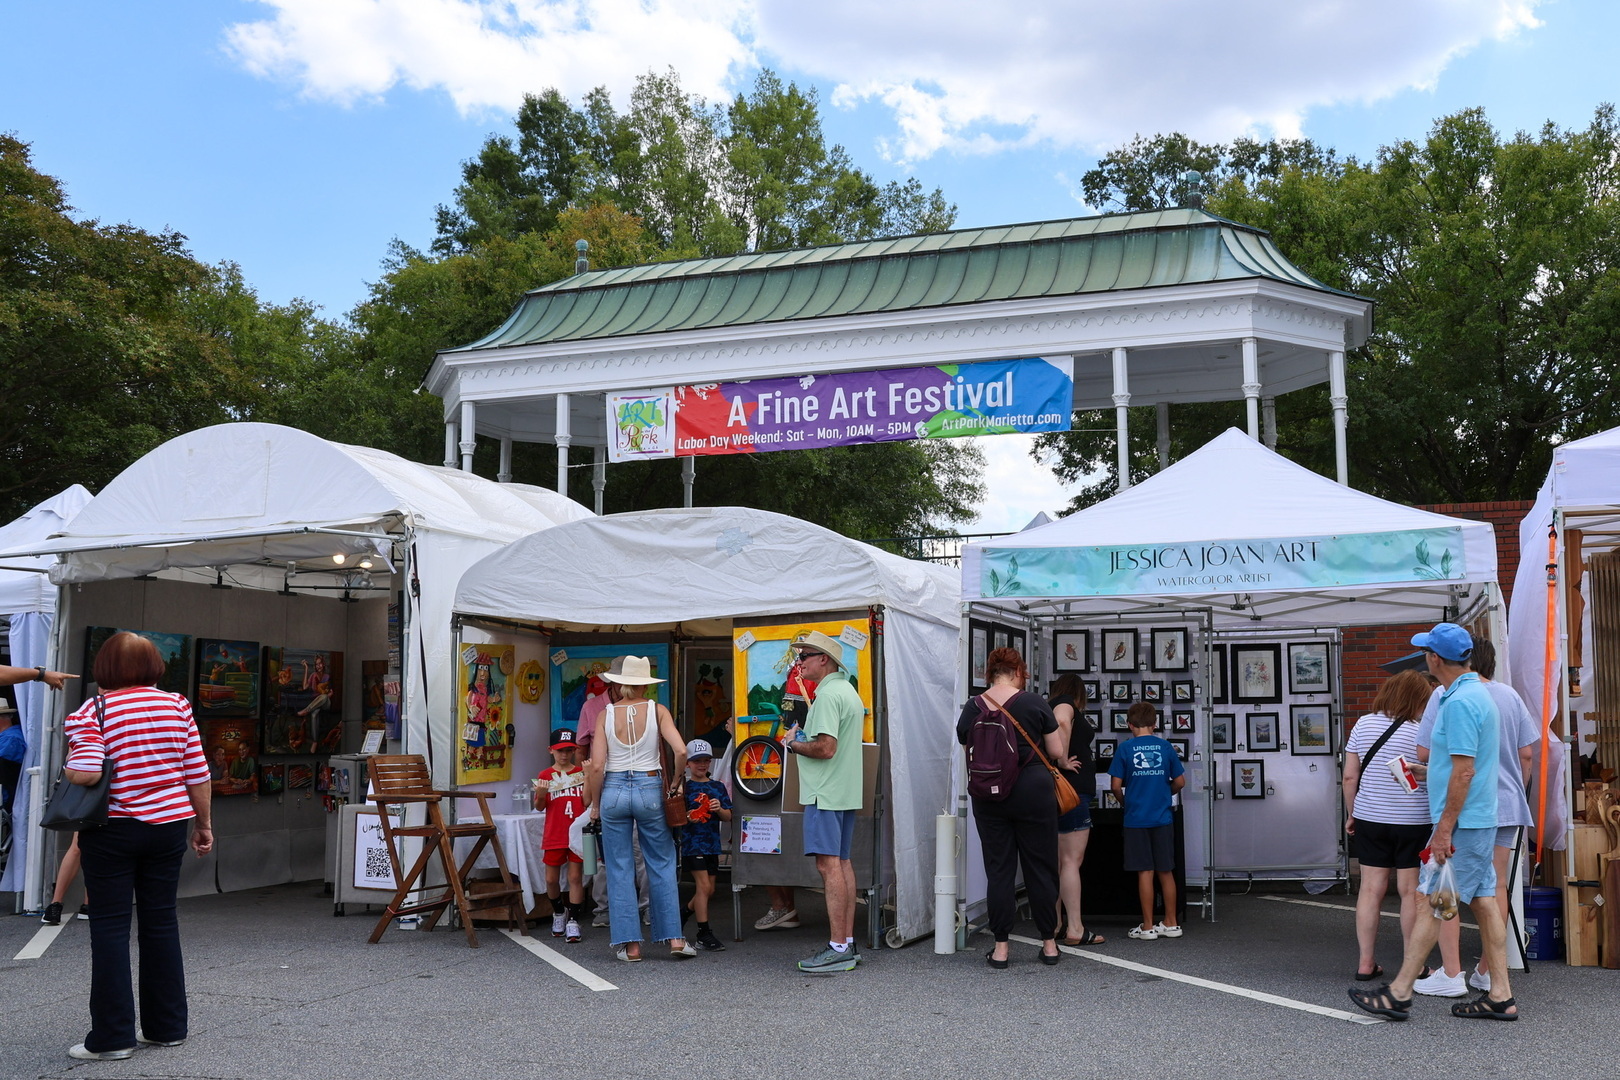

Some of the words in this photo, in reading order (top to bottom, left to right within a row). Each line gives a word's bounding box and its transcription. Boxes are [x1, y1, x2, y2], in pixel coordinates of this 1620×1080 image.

[727, 395, 748, 427] A
[758, 390, 819, 425] Fine
[829, 386, 877, 420] Art
[889, 371, 1013, 416] Festival
[621, 397, 662, 429] ART
[941, 412, 1062, 431] ArtParkMarietta.com
[619, 424, 659, 449] Park
[678, 437, 708, 450] Labor
[710, 435, 730, 450] Day
[732, 430, 784, 448] Weekend:
[786, 429, 804, 442] Sat
[817, 427, 842, 440] Mon,
[845, 424, 874, 437] 10AM
[887, 422, 911, 434] 5PM
[1108, 547, 1194, 575] JESSICA
[1199, 543, 1265, 572] JOAN
[1273, 541, 1321, 564] ART
[1157, 573, 1234, 587] WATERCOLOR
[1236, 572, 1273, 584] ARTIST
[564, 800, 573, 818] 4
